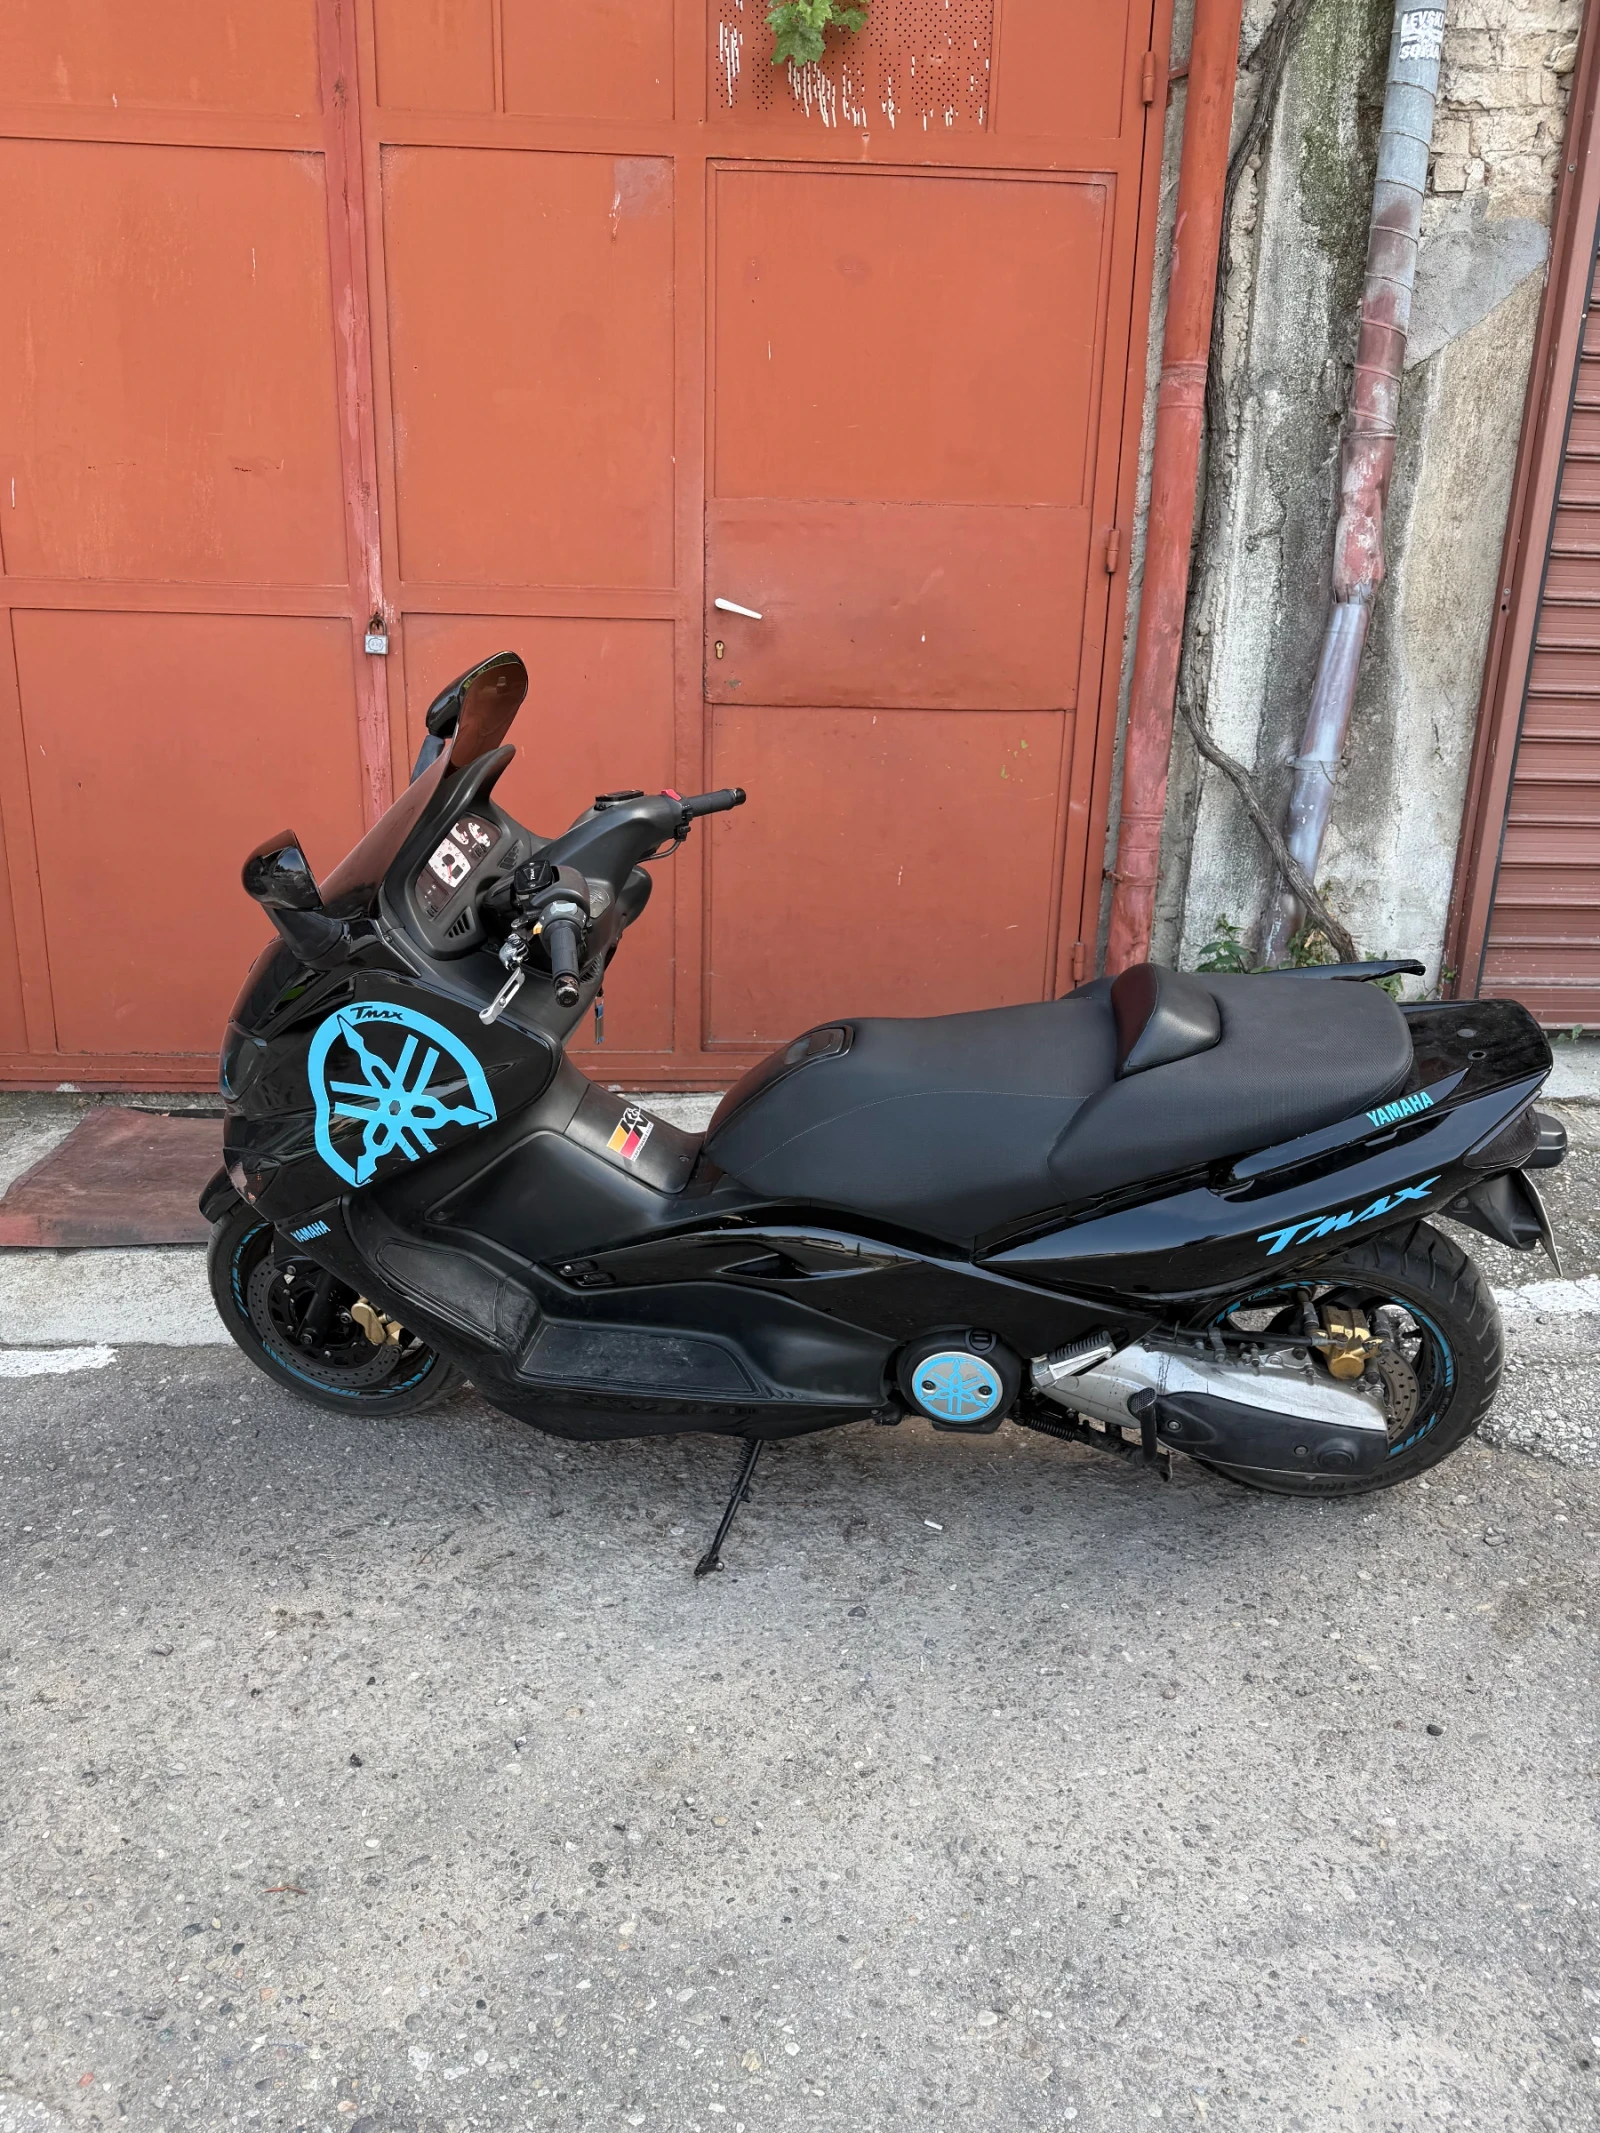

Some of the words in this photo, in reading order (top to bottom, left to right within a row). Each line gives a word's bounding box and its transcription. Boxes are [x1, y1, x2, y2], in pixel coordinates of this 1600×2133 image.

[1401, 10, 1444, 29] LEVSKI
[1365, 1091, 1434, 1128] YAMAHA
[290, 1220, 331, 1243] YAMAHA
